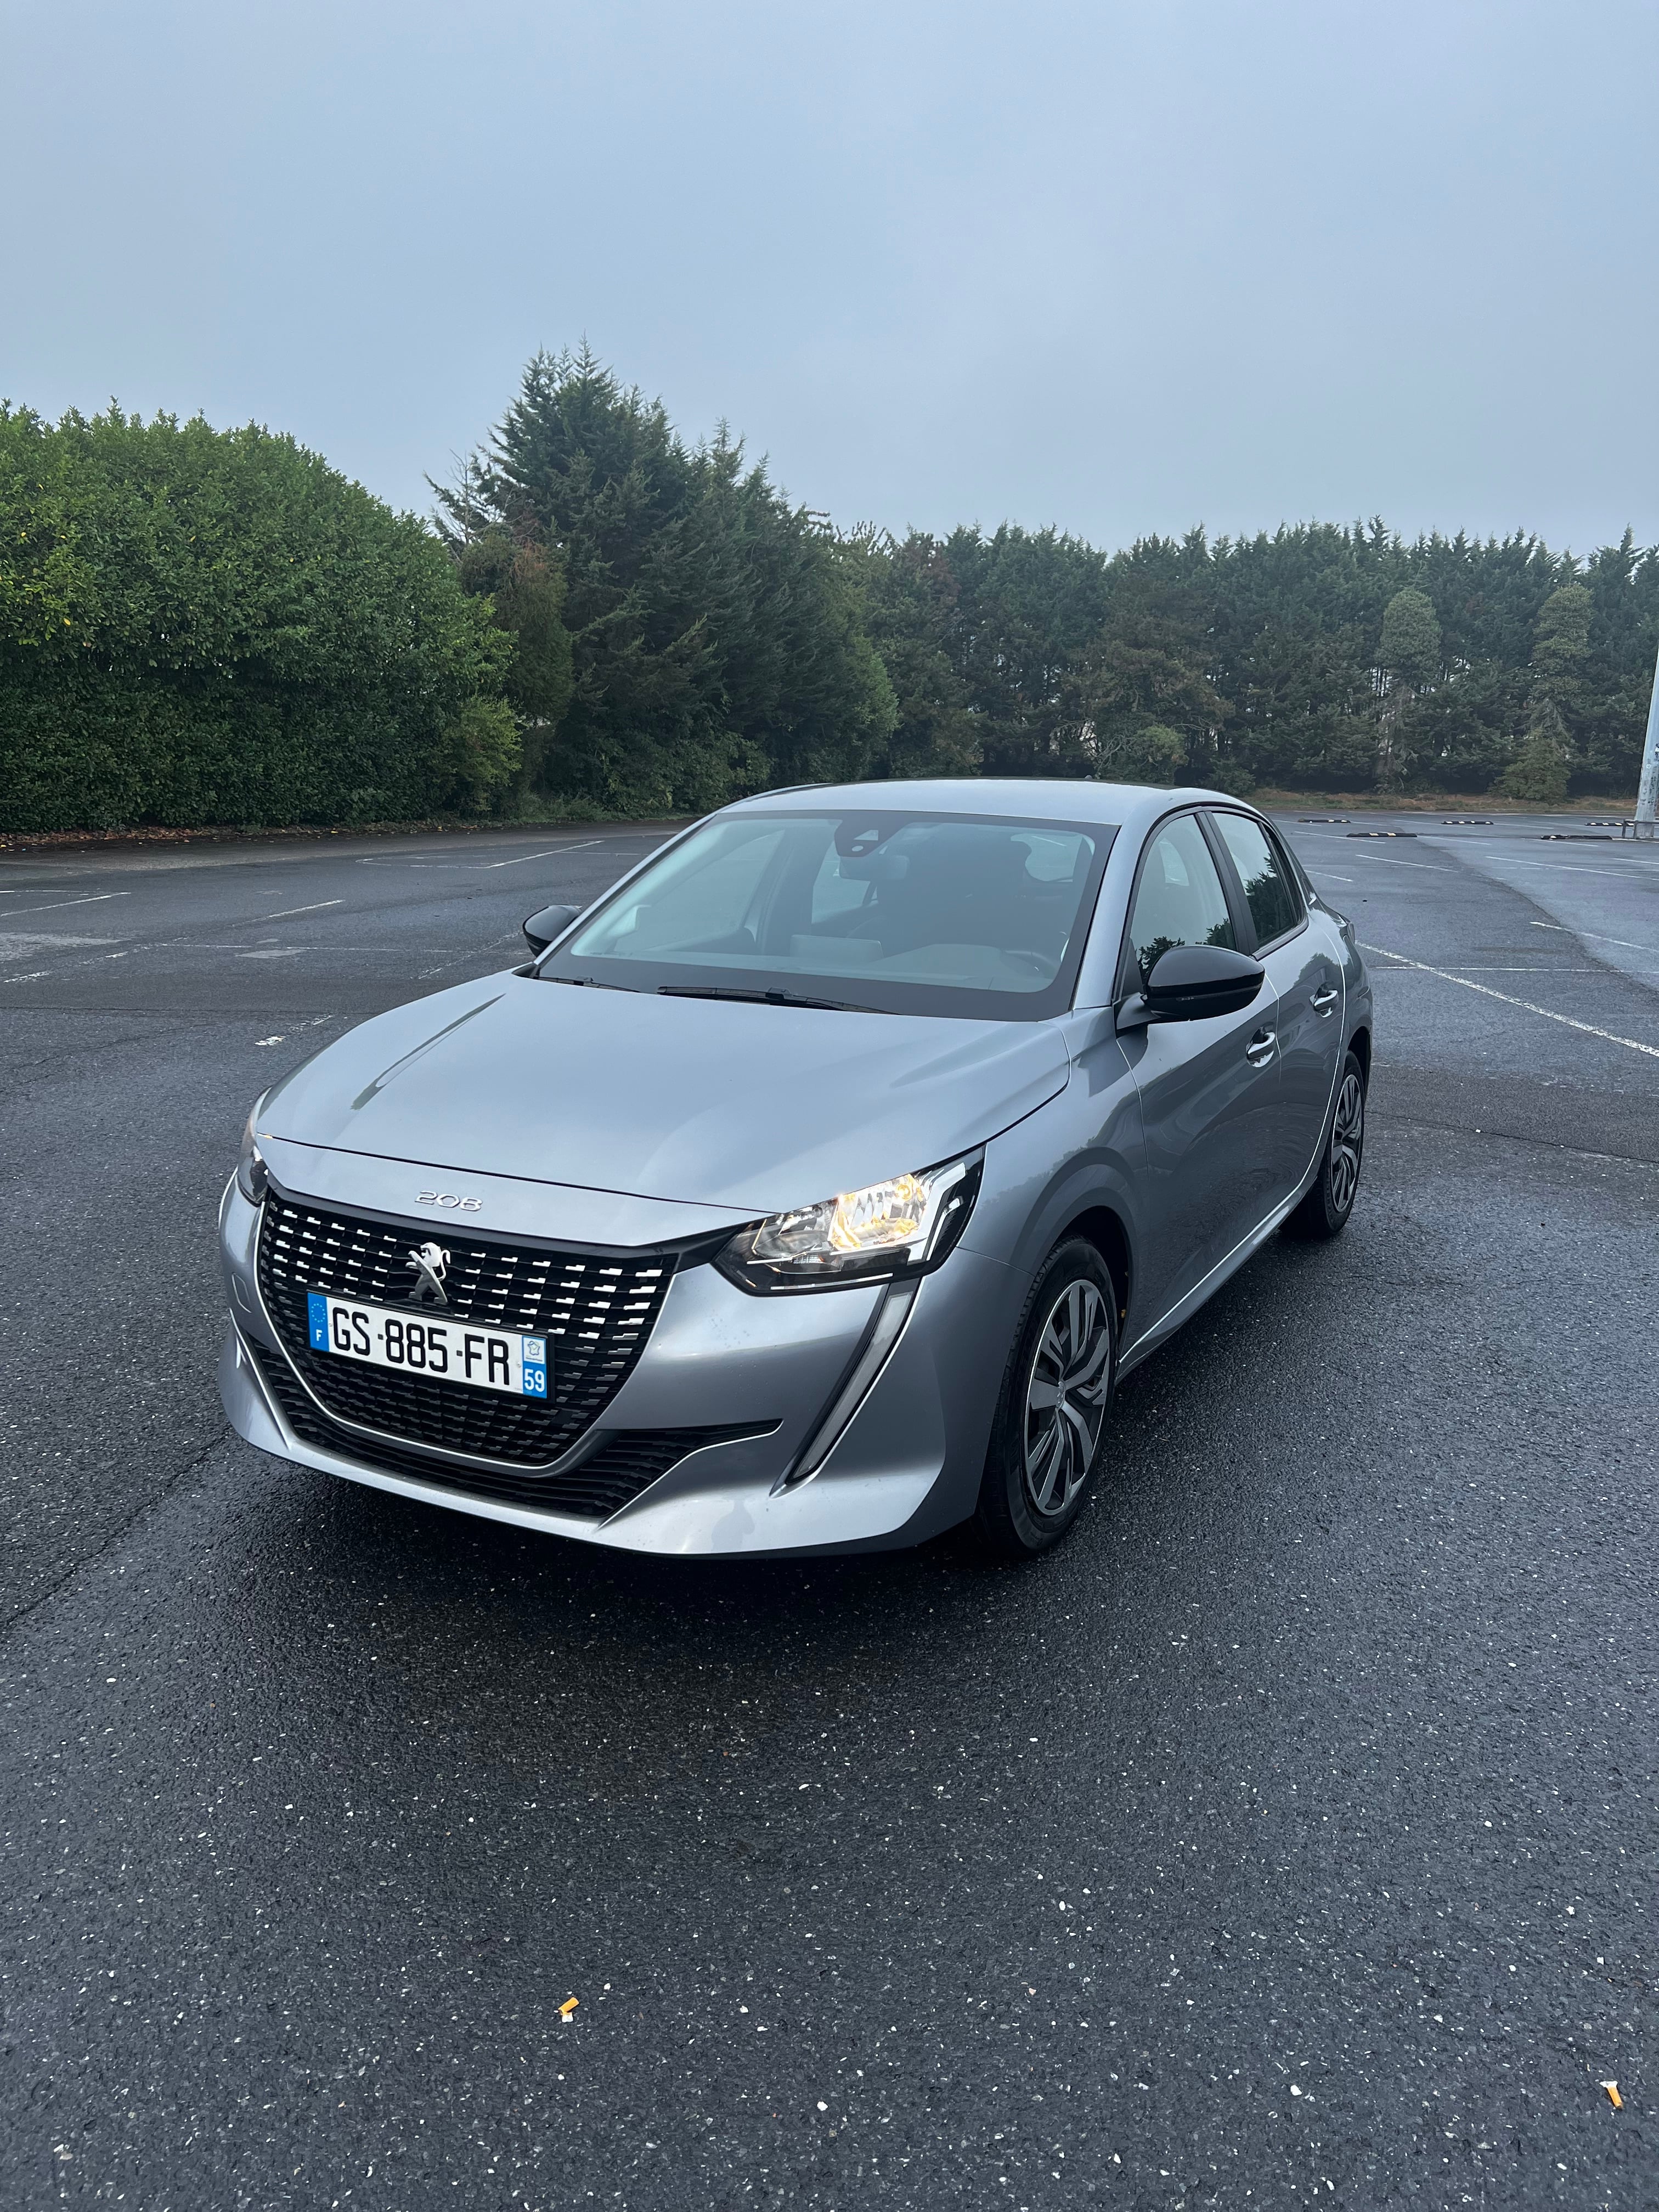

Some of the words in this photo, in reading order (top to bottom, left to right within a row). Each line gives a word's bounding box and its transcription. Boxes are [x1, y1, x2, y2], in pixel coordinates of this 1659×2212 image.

[415, 1190, 483, 1211] 208
[315, 1329, 323, 1342] F
[524, 1368, 545, 1392] 59
